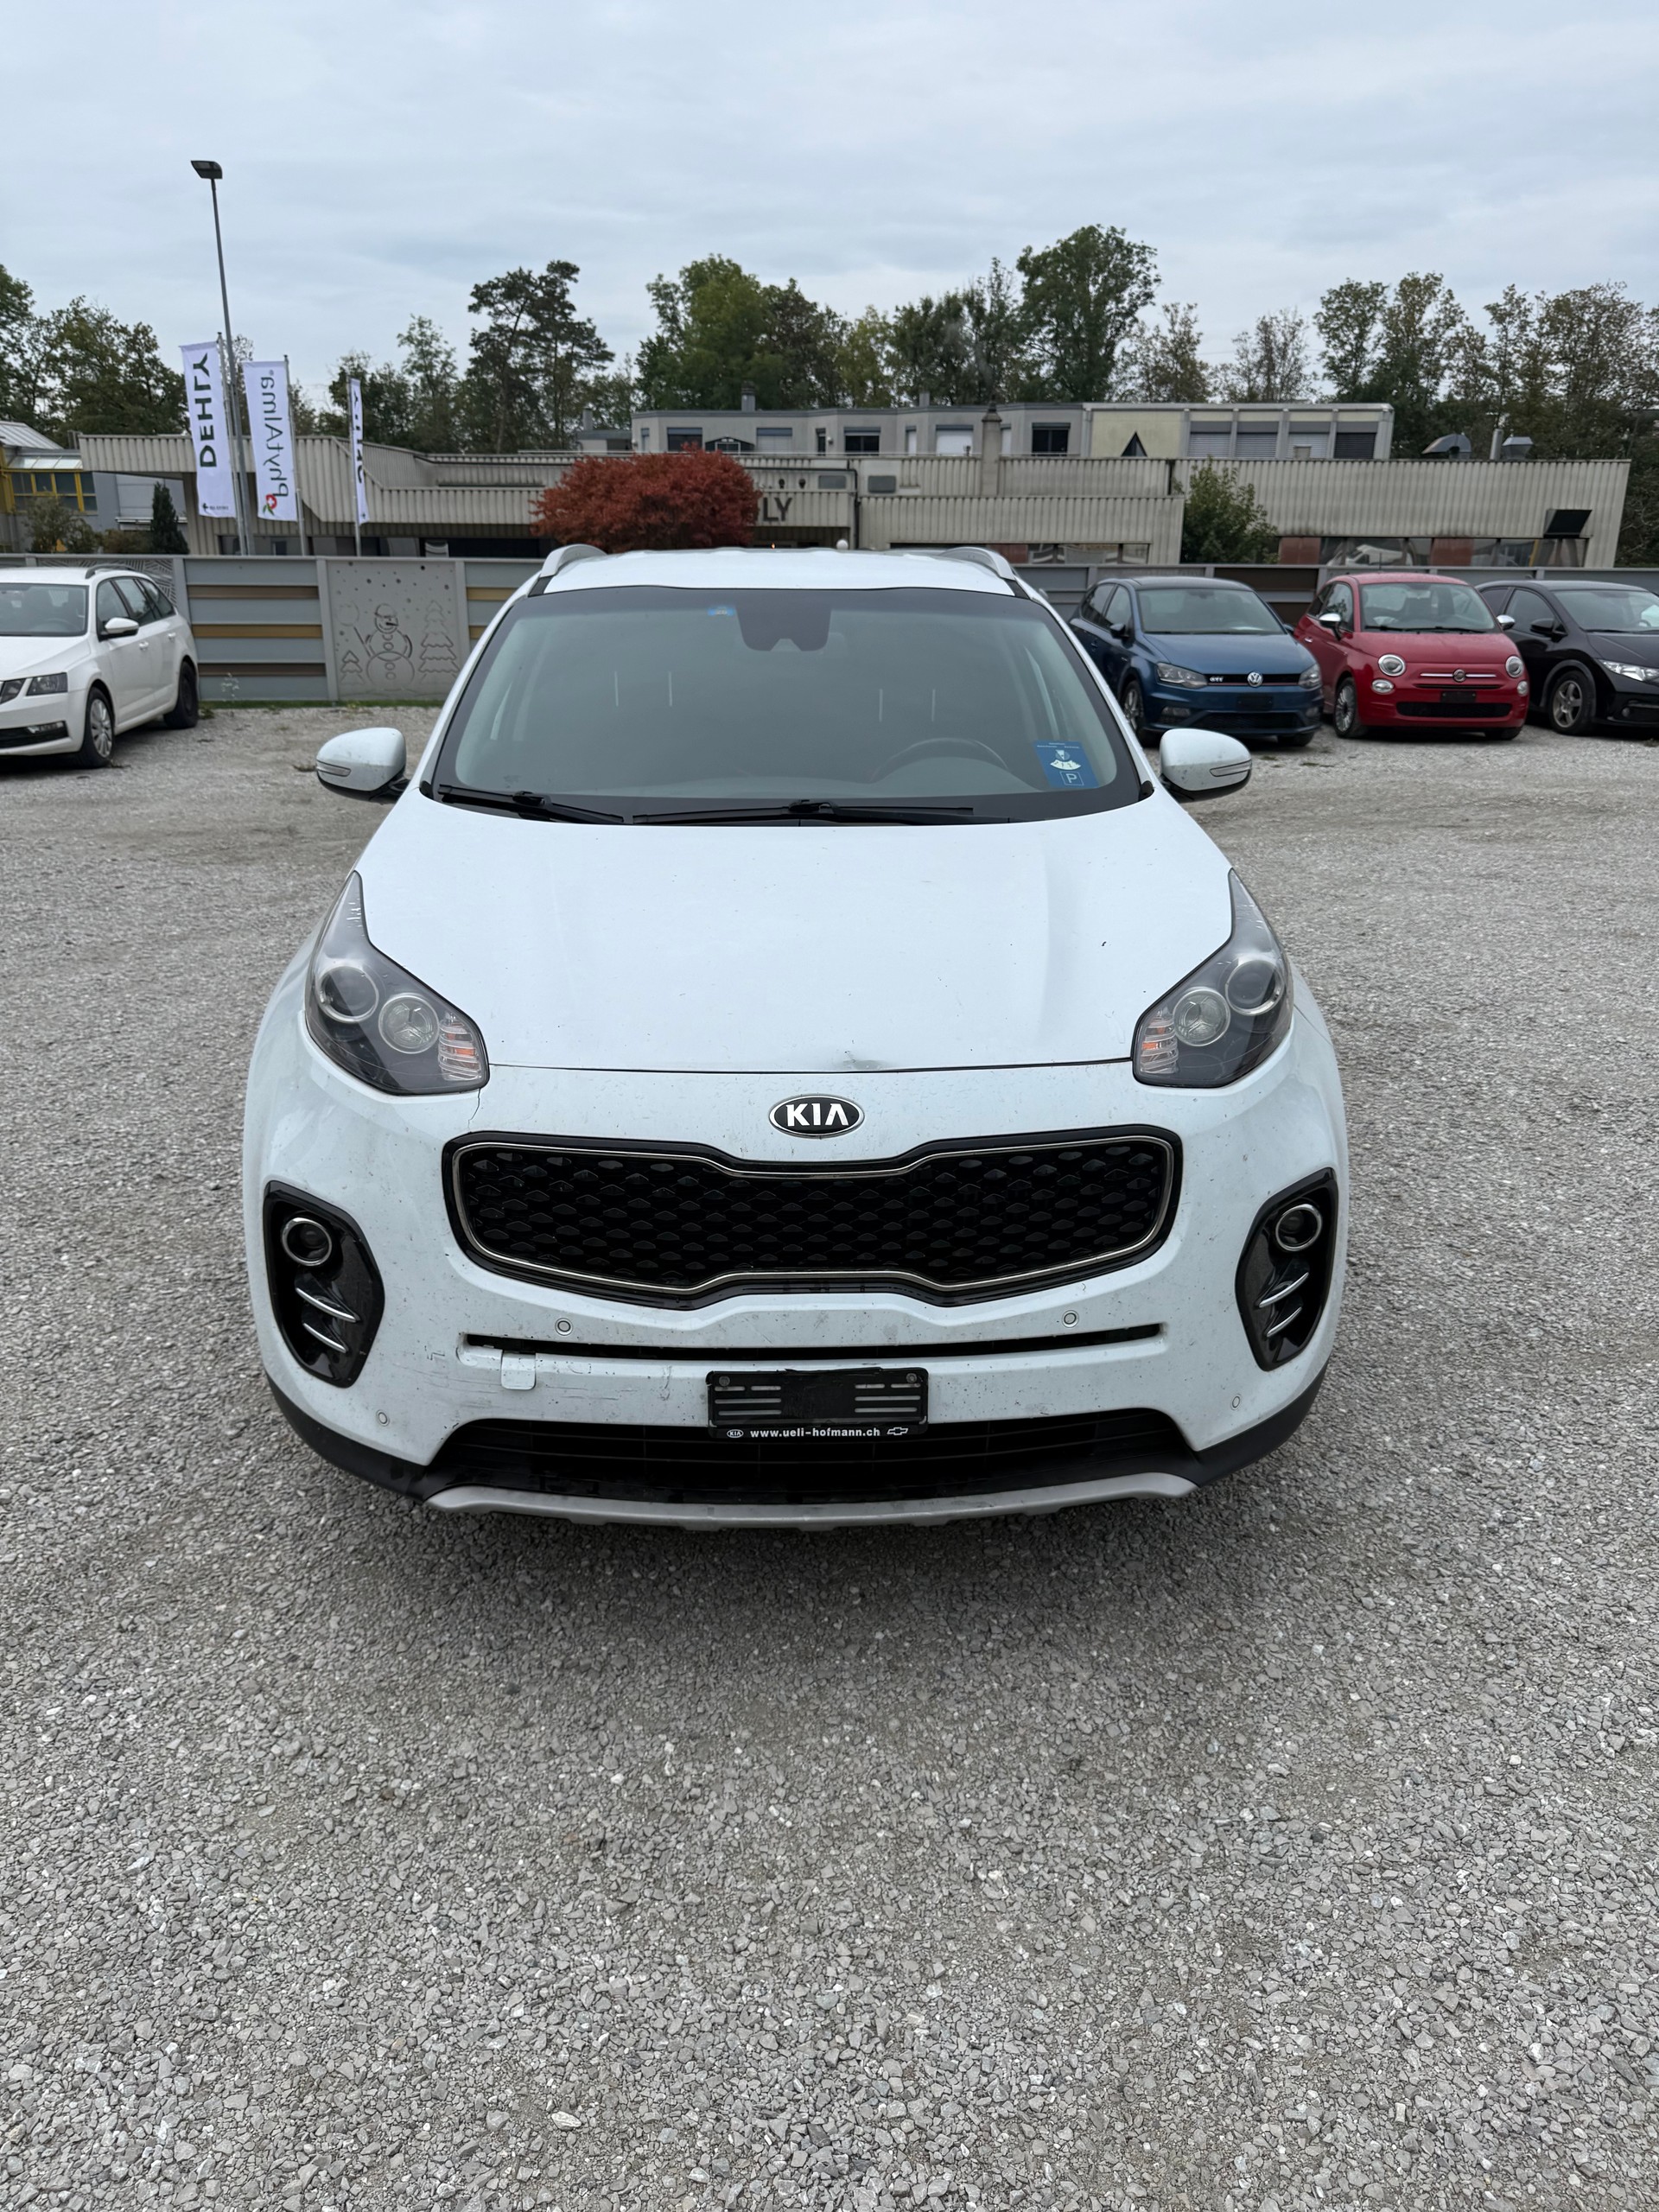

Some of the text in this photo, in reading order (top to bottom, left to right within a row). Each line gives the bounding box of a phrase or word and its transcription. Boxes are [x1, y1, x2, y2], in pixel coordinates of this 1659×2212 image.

[763, 497, 792, 522] LY
[785, 1103, 849, 1127] KIA
[750, 1427, 880, 1438] www.ueli-hofmann.ch
